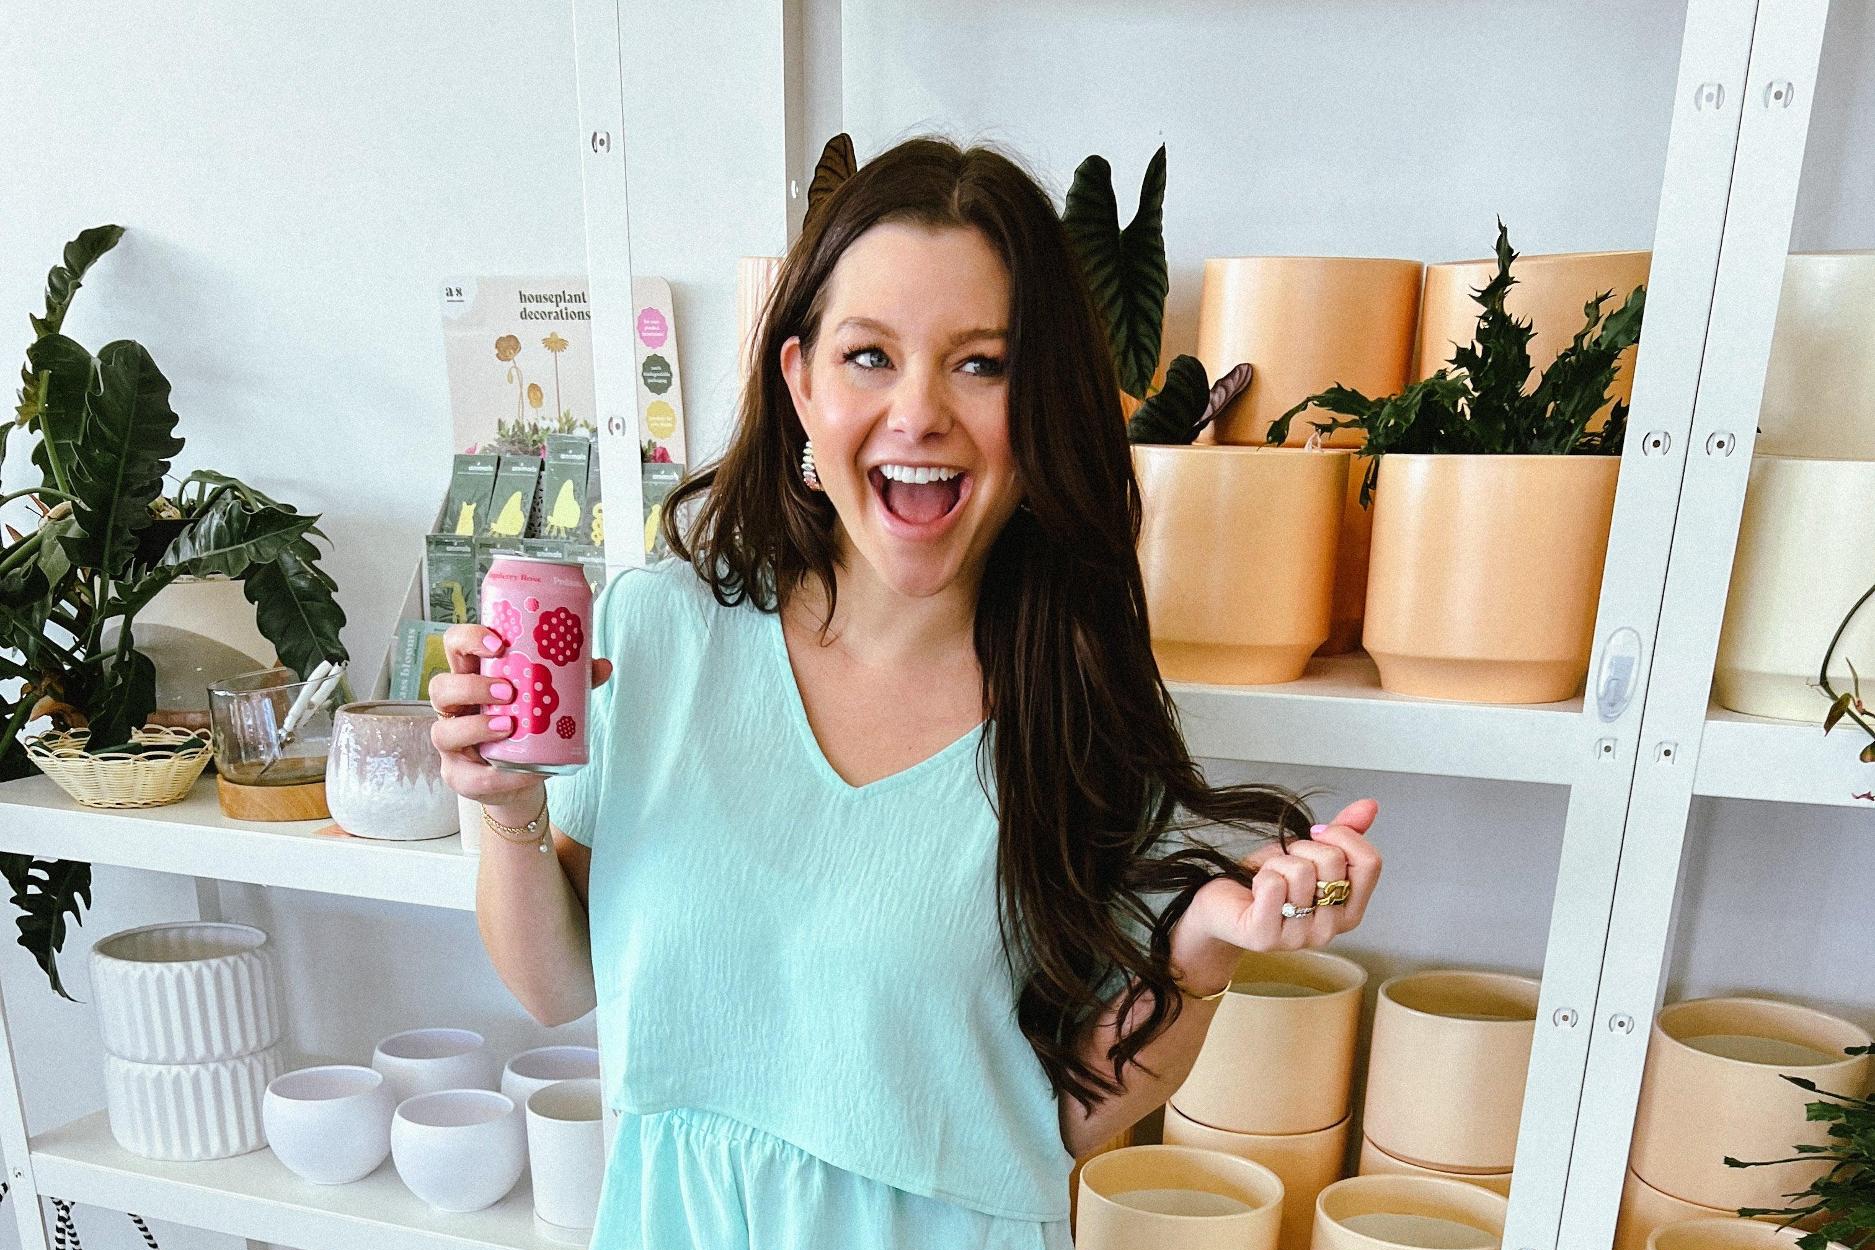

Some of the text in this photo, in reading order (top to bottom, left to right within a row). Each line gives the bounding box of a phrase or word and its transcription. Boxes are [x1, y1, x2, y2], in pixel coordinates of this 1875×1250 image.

[518, 290, 587, 307] houseplant
[519, 307, 592, 320] decorations
[401, 628, 416, 676] blooms
